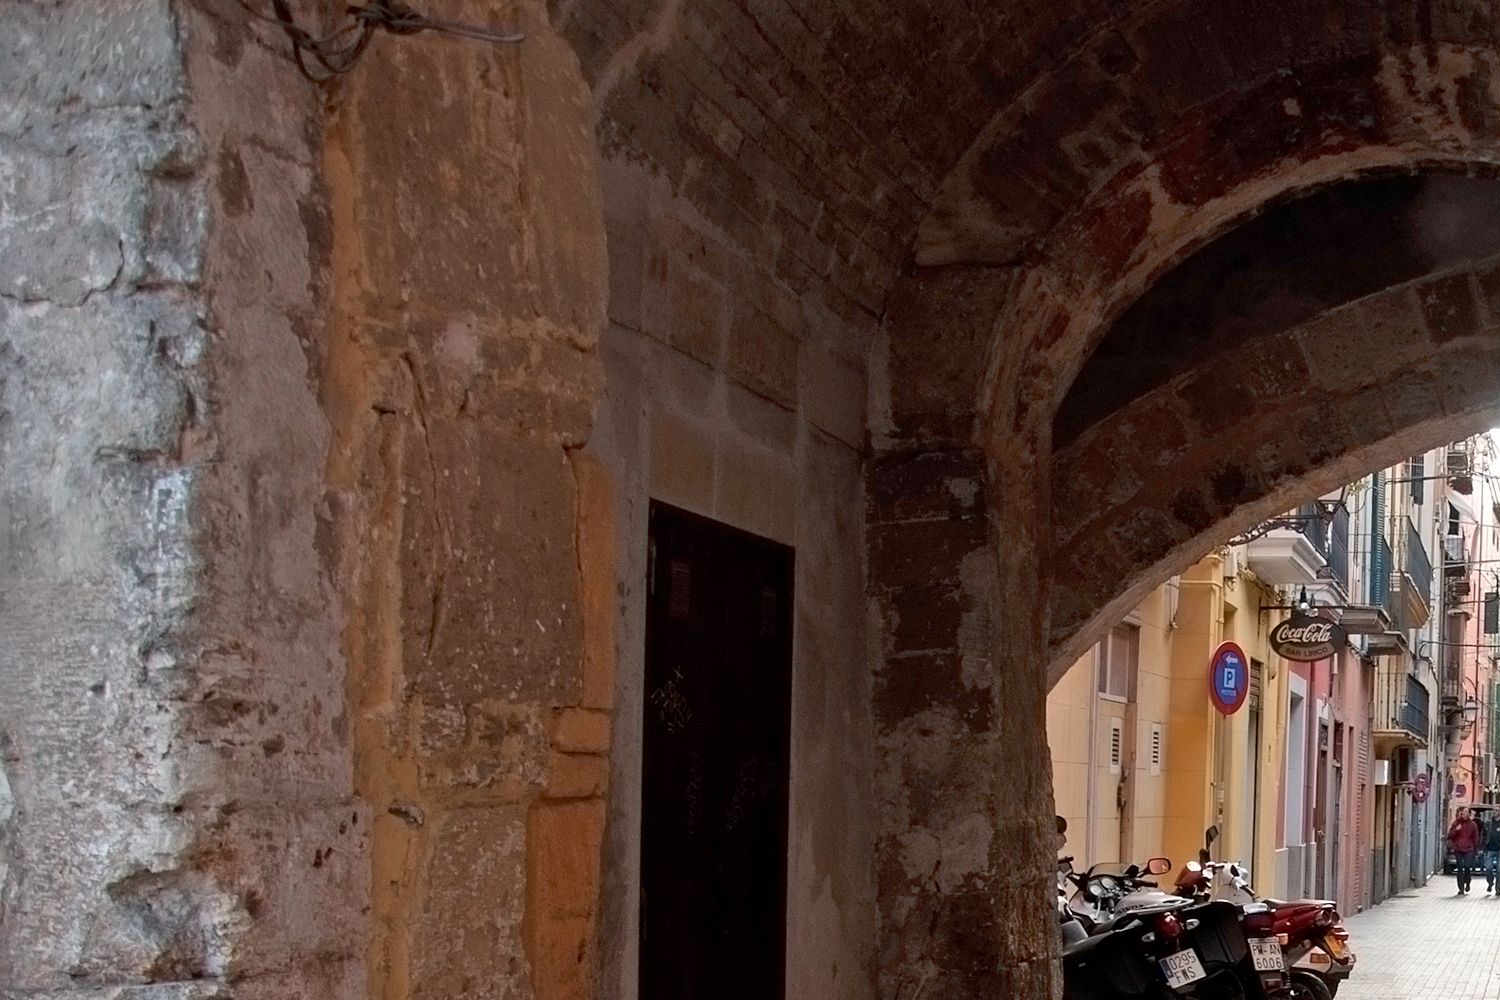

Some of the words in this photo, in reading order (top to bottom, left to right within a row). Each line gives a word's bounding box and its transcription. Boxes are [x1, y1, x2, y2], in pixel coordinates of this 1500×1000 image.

[1169, 951, 1196, 970] 0295
[1256, 957, 1282, 969] 6006
[1174, 966, 1196, 984] FWS
